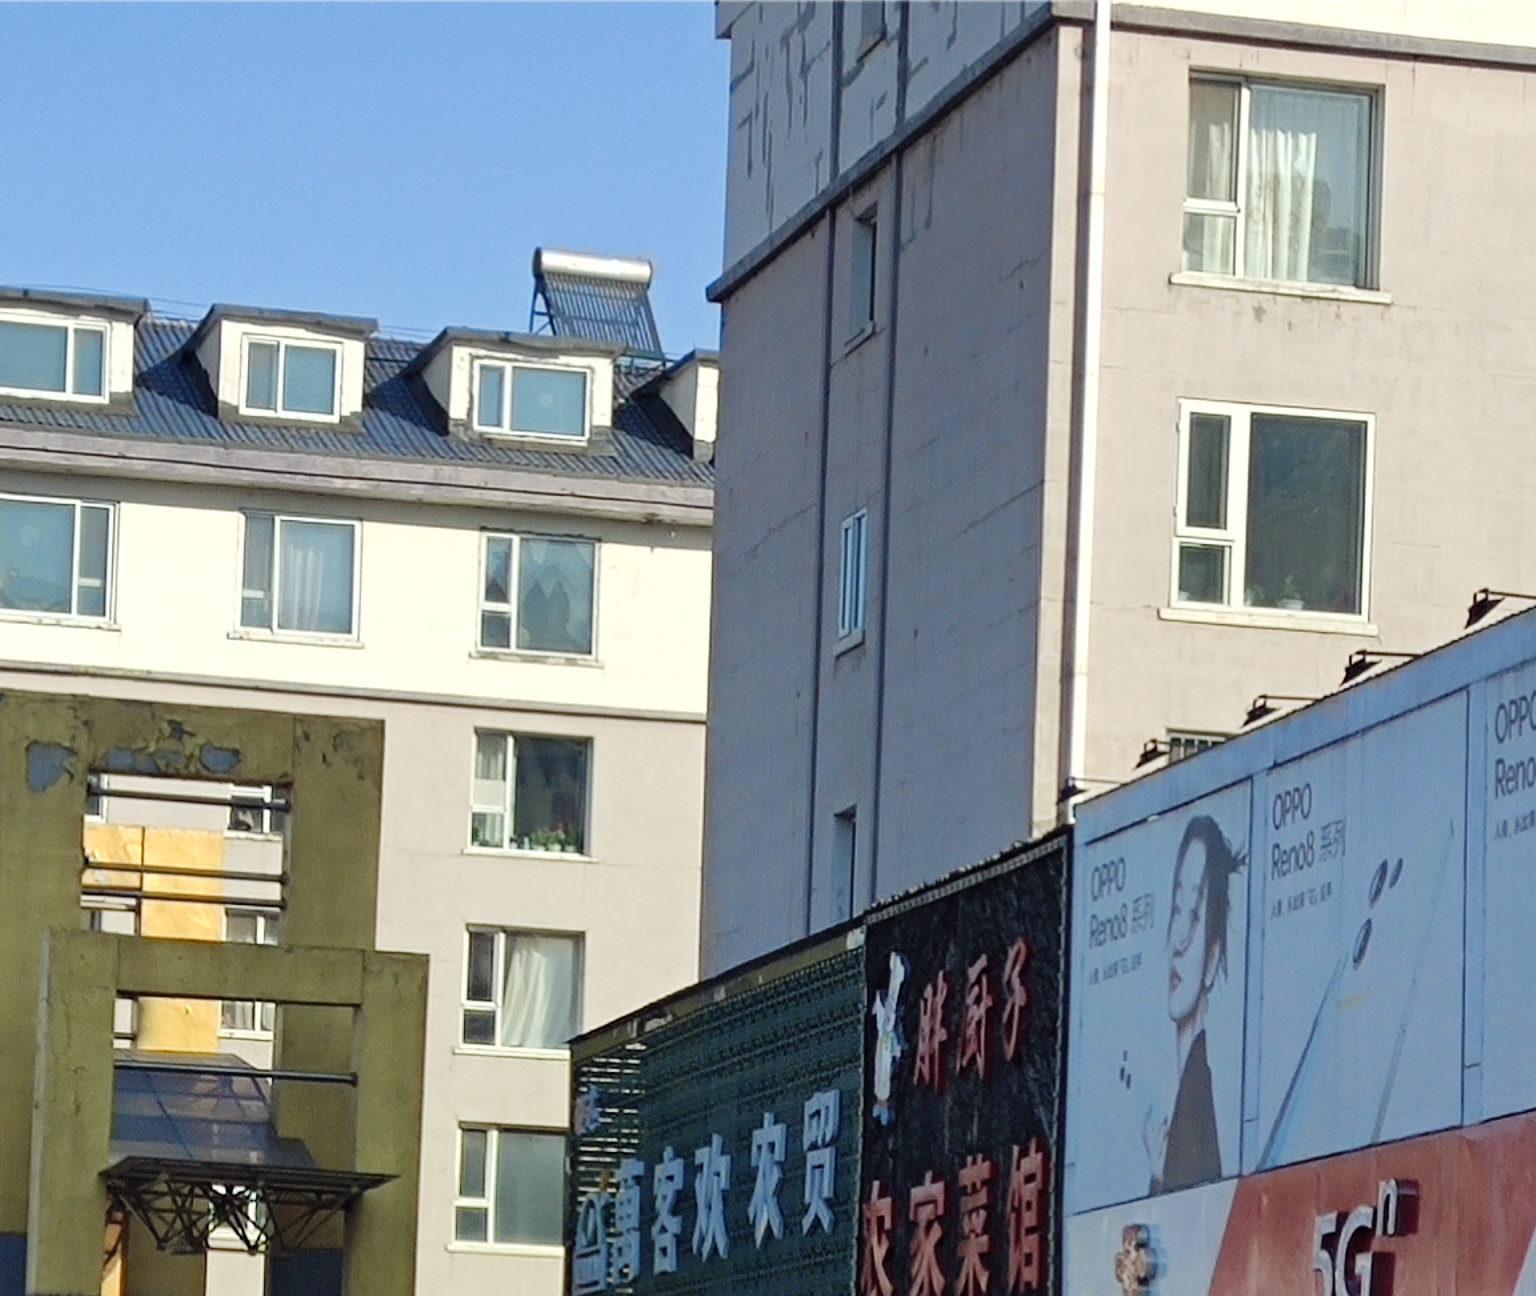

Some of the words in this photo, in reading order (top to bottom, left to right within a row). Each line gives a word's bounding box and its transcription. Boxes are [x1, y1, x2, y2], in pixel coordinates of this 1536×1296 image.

[1273, 782, 1312, 831] OPPO
[1091, 857, 1126, 901] OPPO
[1271, 829, 1315, 881] Reno8
[1089, 903, 1128, 949] Reno8
[914, 936, 1029, 1096] 胖厨子
